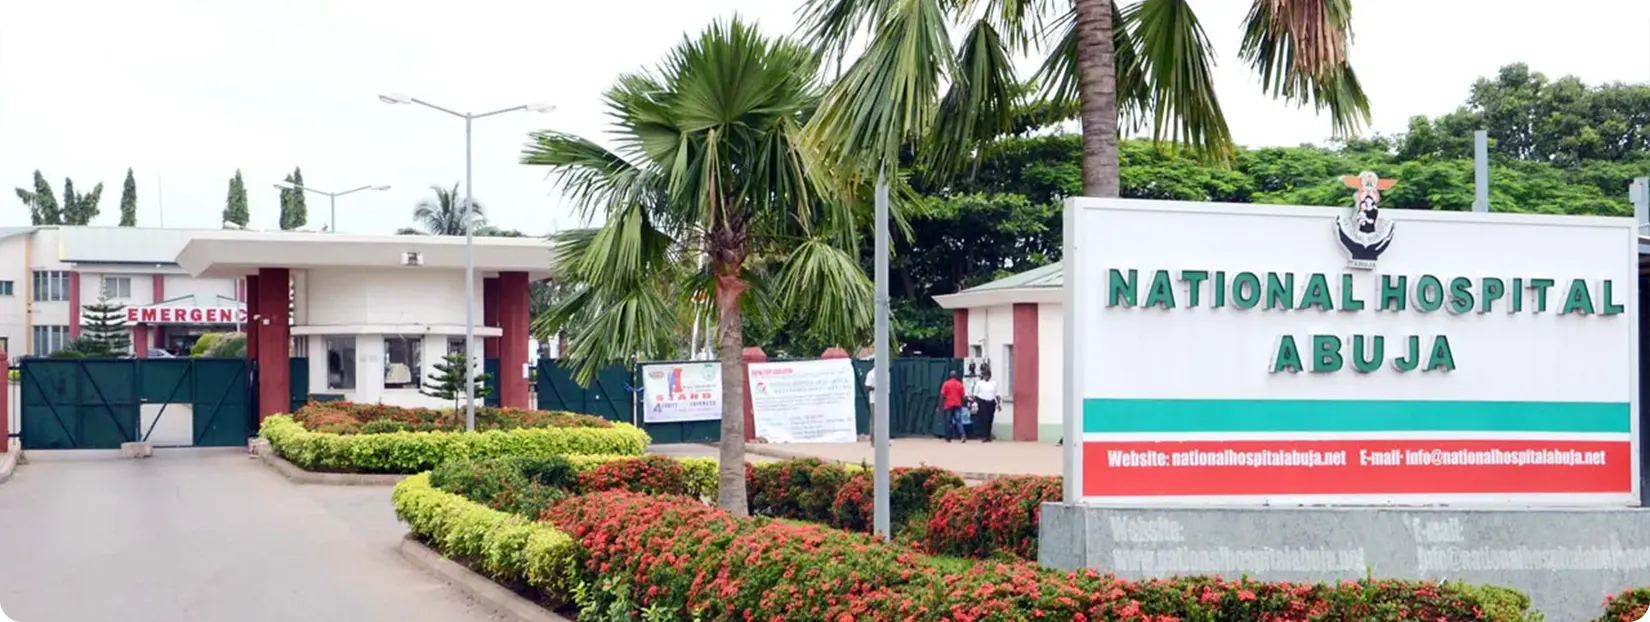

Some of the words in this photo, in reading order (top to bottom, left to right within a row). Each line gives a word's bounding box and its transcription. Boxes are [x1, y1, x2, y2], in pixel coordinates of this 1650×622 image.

[1106, 268, 1366, 312] NATIONAL
[1375, 273, 1625, 316] HOSPITAL
[1268, 334, 1457, 374] ABUJA
[1107, 450, 1170, 467] Website:
[1172, 450, 1347, 468] nationalhospitalabuja.net
